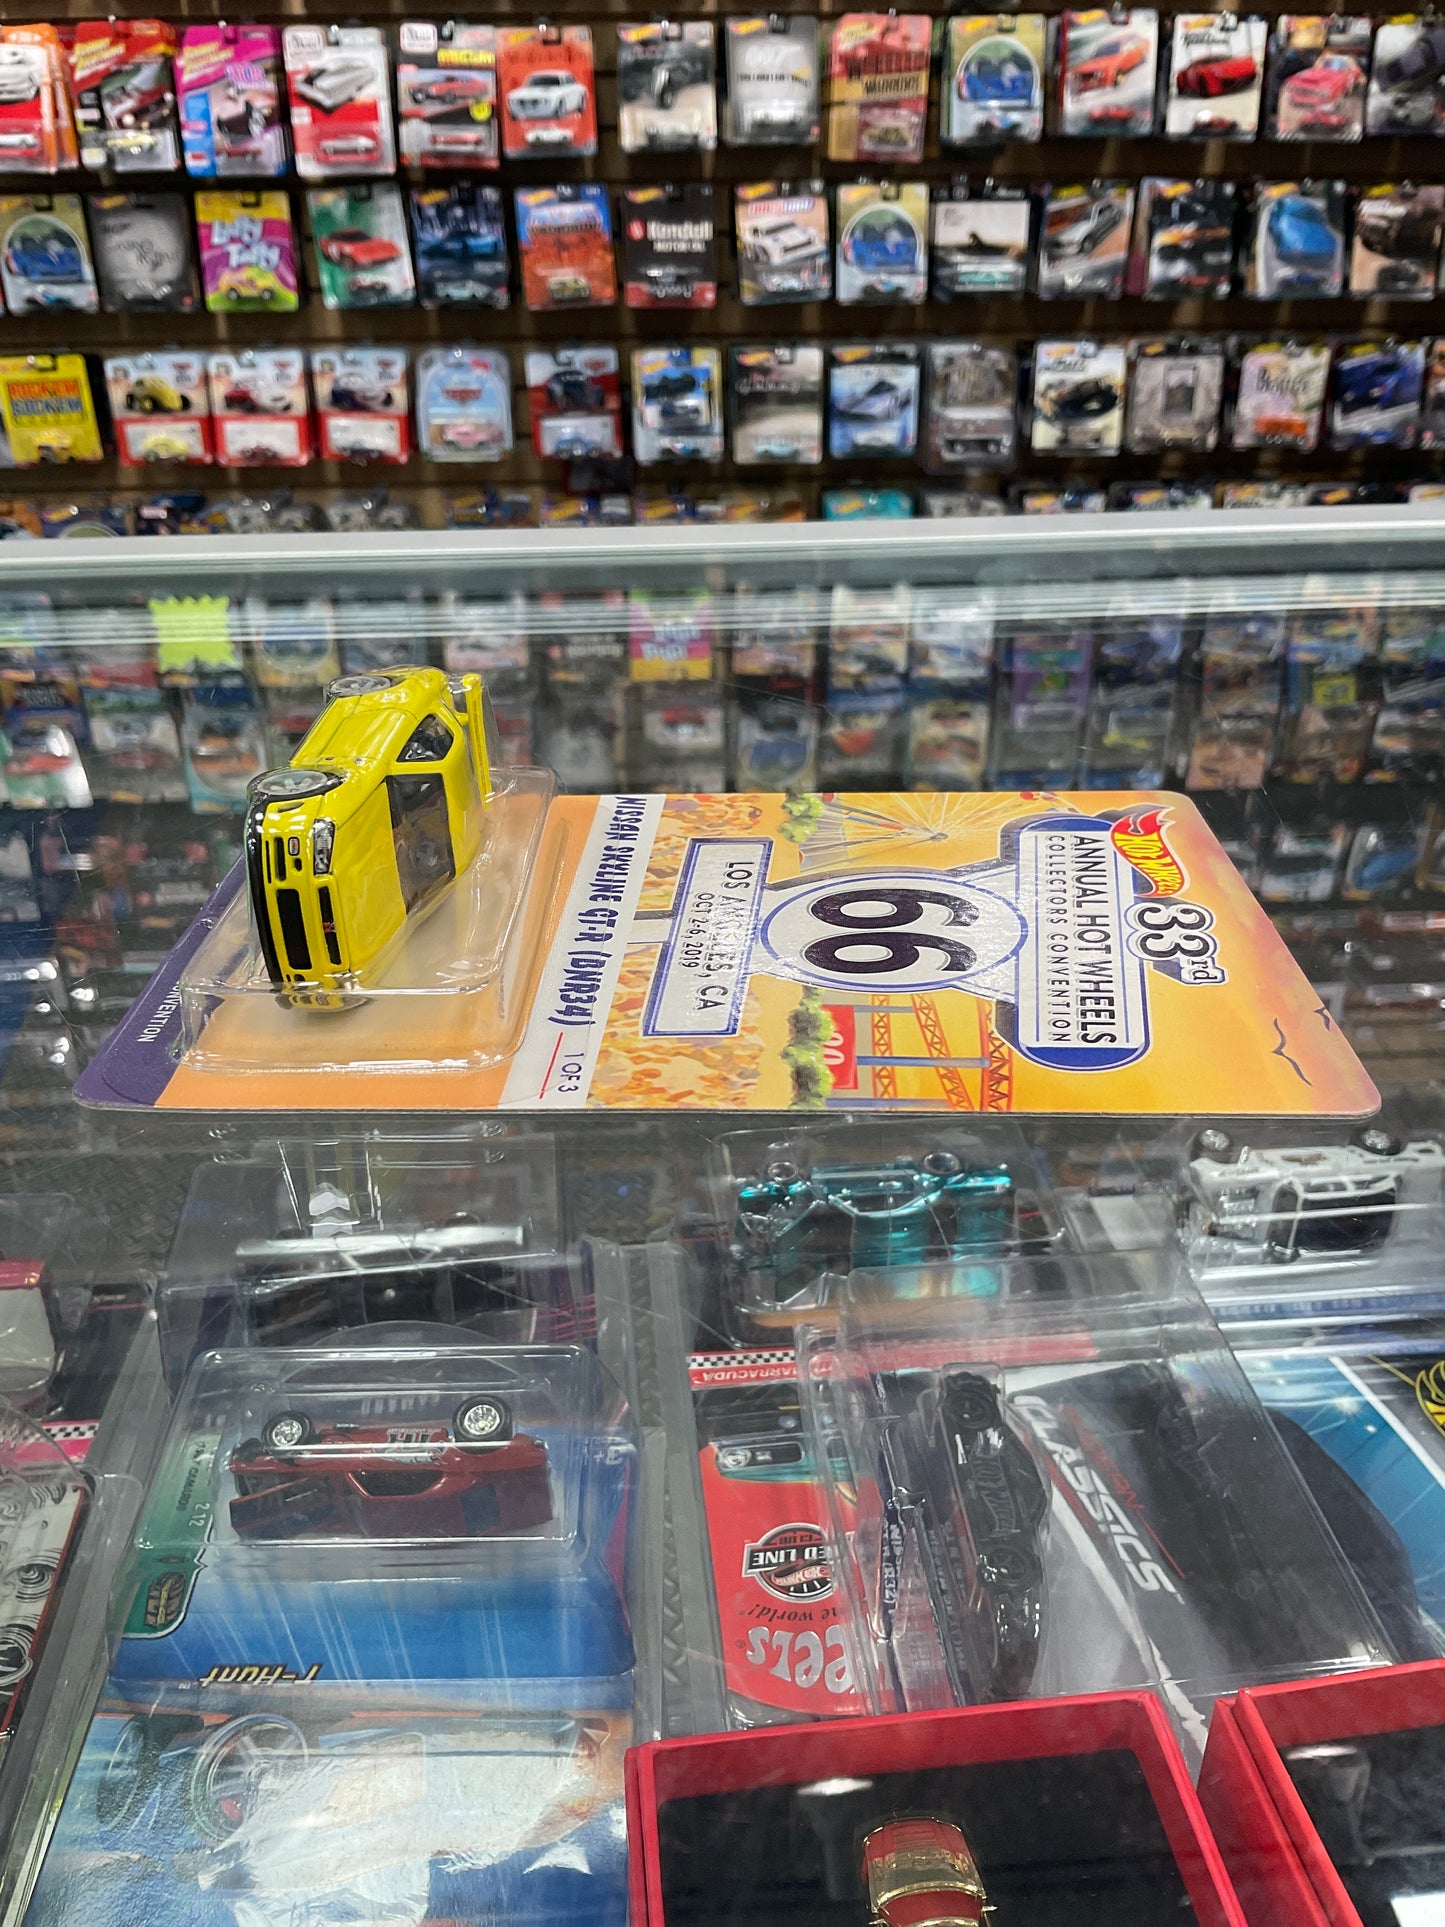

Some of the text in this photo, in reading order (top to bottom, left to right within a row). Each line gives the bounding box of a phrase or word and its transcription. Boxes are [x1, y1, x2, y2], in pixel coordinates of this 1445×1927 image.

[723, 860, 756, 889] LOS
[547, 796, 648, 1026] NISSAN SKYLINE GT-R (BNR34)
[693, 892, 715, 919] OCT
[802, 887, 981, 975] 66
[1046, 835, 1071, 1043] COLLECTORS CONVENTION
[1073, 835, 1117, 1044] ANNUAL HOT WHEELS
[681, 941, 704, 969] 2019
[695, 984, 728, 1011] CA
[560, 1062, 583, 1081] OF
[557, 1084, 580, 1093] 3
[1013, 1394, 1175, 1593] CLASSICS
[752, 1548, 797, 1567] LINE
[747, 1603, 814, 1624] world!
[746, 1625, 855, 1694] eels
[199, 1662, 324, 1688] T-Hunt
